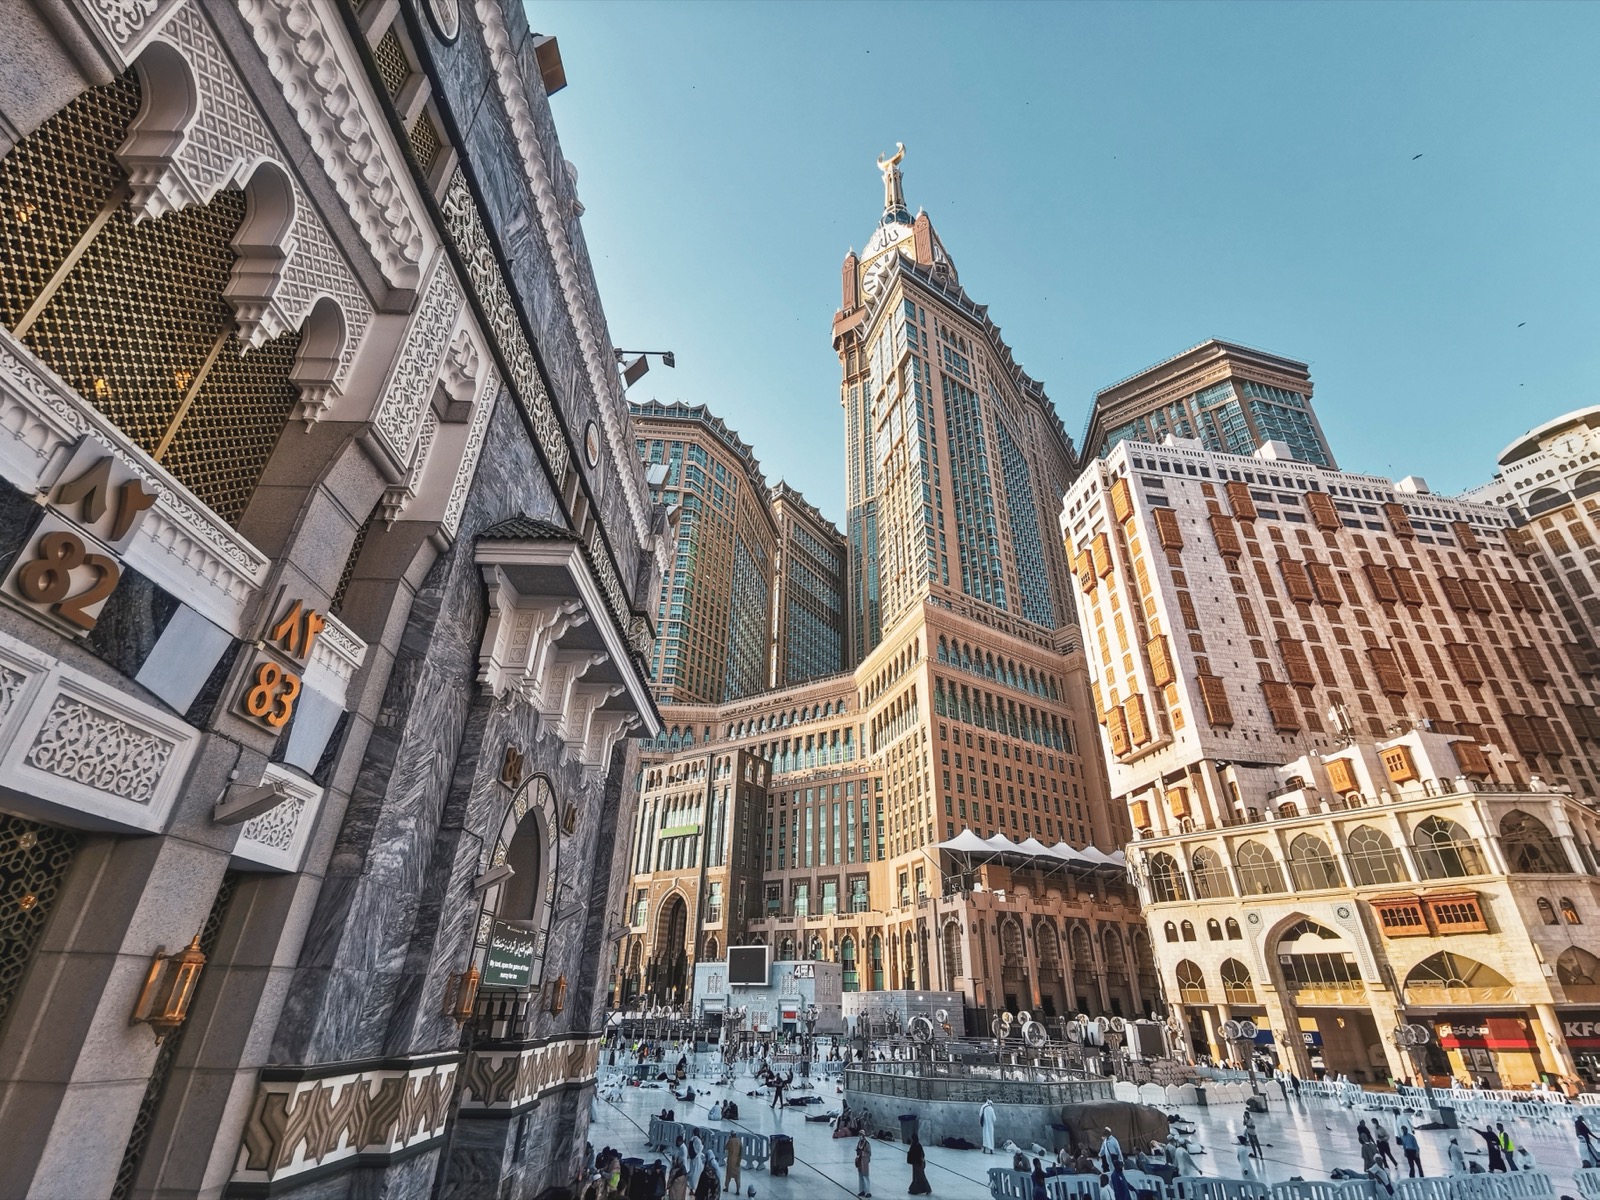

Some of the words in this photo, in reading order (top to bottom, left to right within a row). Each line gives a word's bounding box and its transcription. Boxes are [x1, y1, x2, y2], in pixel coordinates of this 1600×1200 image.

[58, 456, 159, 542] ٨٢
[19, 531, 120, 631] 82
[272, 598, 326, 660] ٨٣
[247, 662, 301, 728] 83
